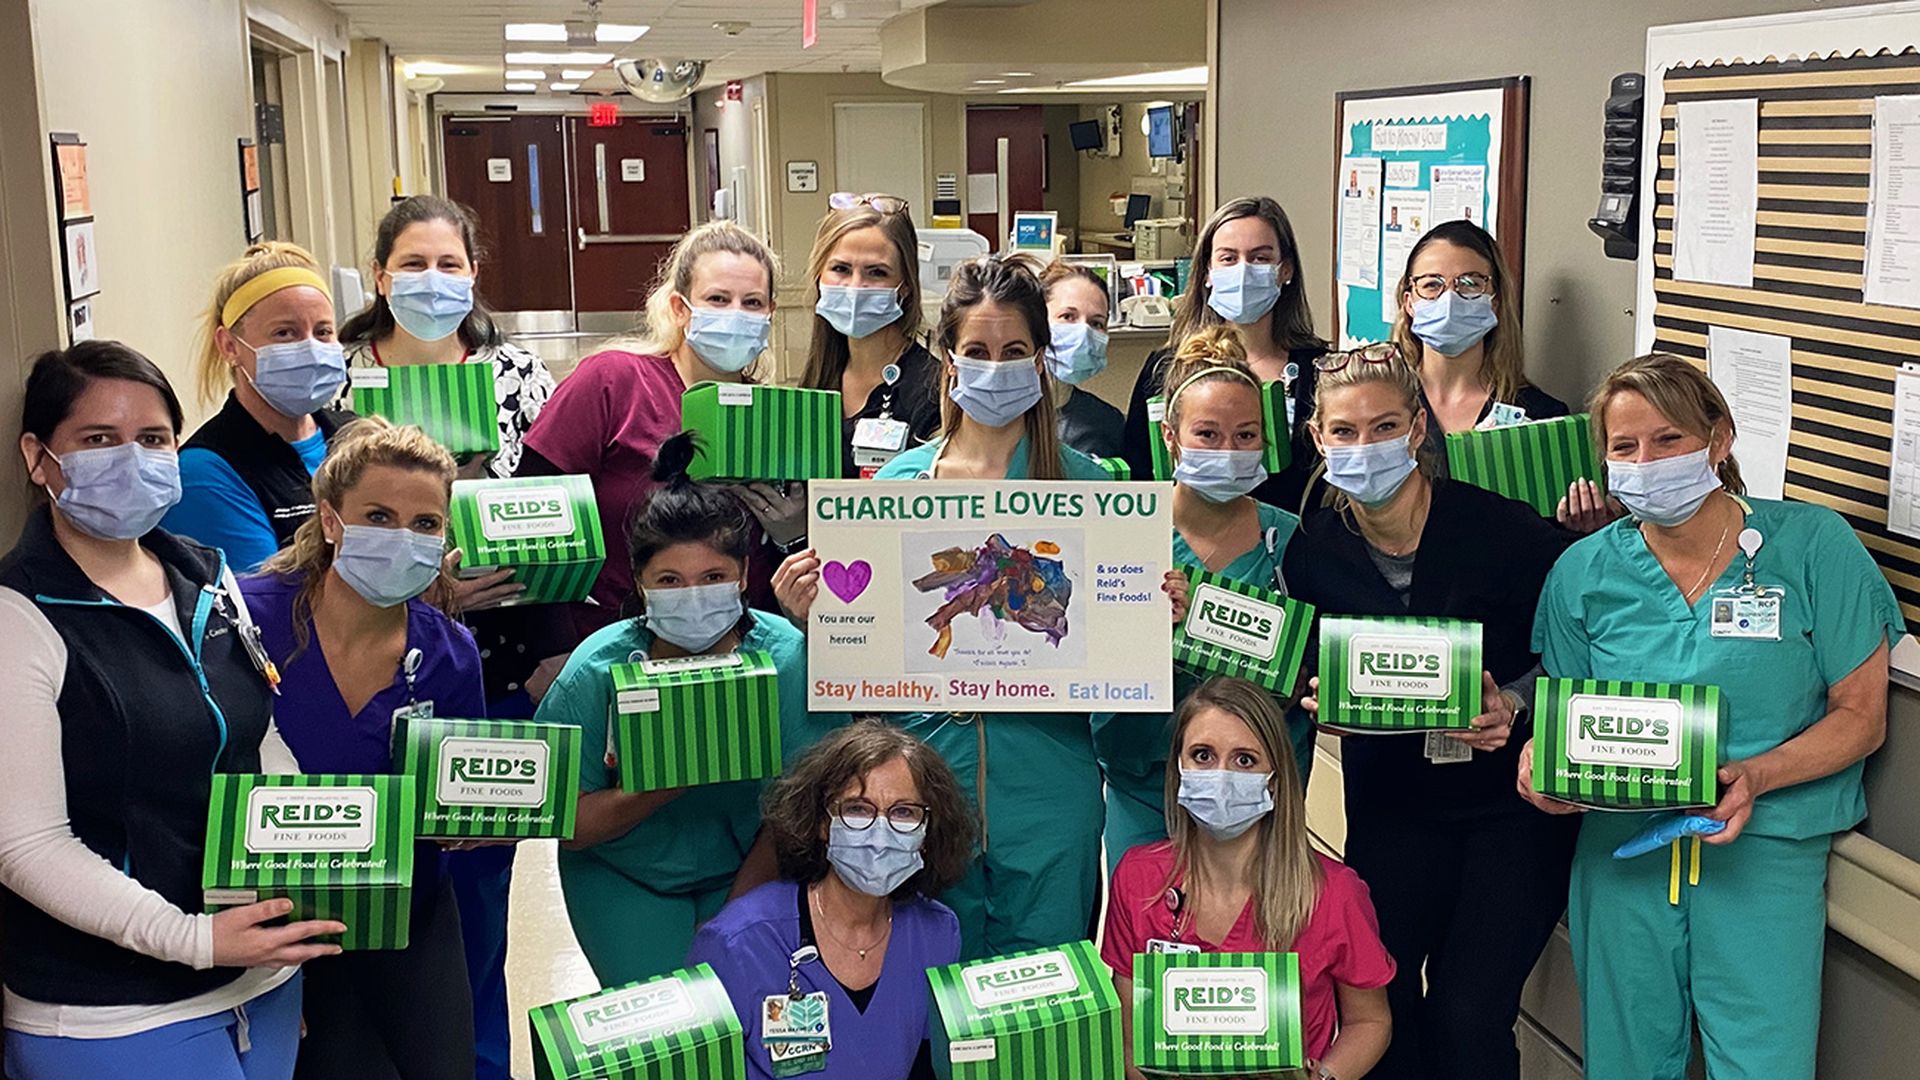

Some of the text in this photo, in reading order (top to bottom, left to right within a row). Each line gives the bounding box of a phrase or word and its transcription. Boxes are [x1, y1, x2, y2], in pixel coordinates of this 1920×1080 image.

[488, 500, 562, 522] REID'S
[816, 491, 1157, 519] CHARLOTTE LOVES YOU
[1096, 564, 1144, 574] & so does
[1096, 579, 1126, 588] Reid's
[1096, 592, 1152, 602] Fine Foods!
[818, 614, 875, 624] You are our
[1199, 600, 1272, 640] REID'S
[829, 635, 866, 644] heroes!
[1205, 626, 1258, 647] FINE FOODS
[1360, 652, 1440, 678] REID'S
[814, 680, 940, 702] Stay healthy.
[949, 680, 1056, 700] Stay home.
[1068, 682, 1154, 700] Eat local.
[1370, 679, 1428, 689] FINE FOODS
[1578, 715, 1670, 745] REID'S
[1590, 746, 1656, 756] FINE FOODS
[450, 757, 537, 784] REID'S
[1555, 768, 1582, 780] Where
[1584, 770, 1608, 781] Good
[1608, 772, 1630, 782] Food
[1642, 775, 1692, 787] Celebrated!
[460, 787, 524, 796] FINE FOODS
[260, 804, 362, 828] REID'S
[424, 812, 450, 821] Where
[452, 812, 476, 821] Good
[476, 812, 497, 822] Food
[507, 814, 555, 824] Celebrated!
[274, 832, 347, 841] FINE FOODS
[231, 860, 262, 870] Where
[264, 860, 292, 869] Good
[292, 860, 318, 869] Food
[330, 859, 387, 869] Celebrated!
[976, 962, 1062, 992] REID'S
[583, 987, 677, 1028] REID'S
[1174, 986, 1256, 1012] REID'S
[1185, 1015, 1246, 1024] FINE FOODS
[788, 1044, 816, 1055] CCRN
